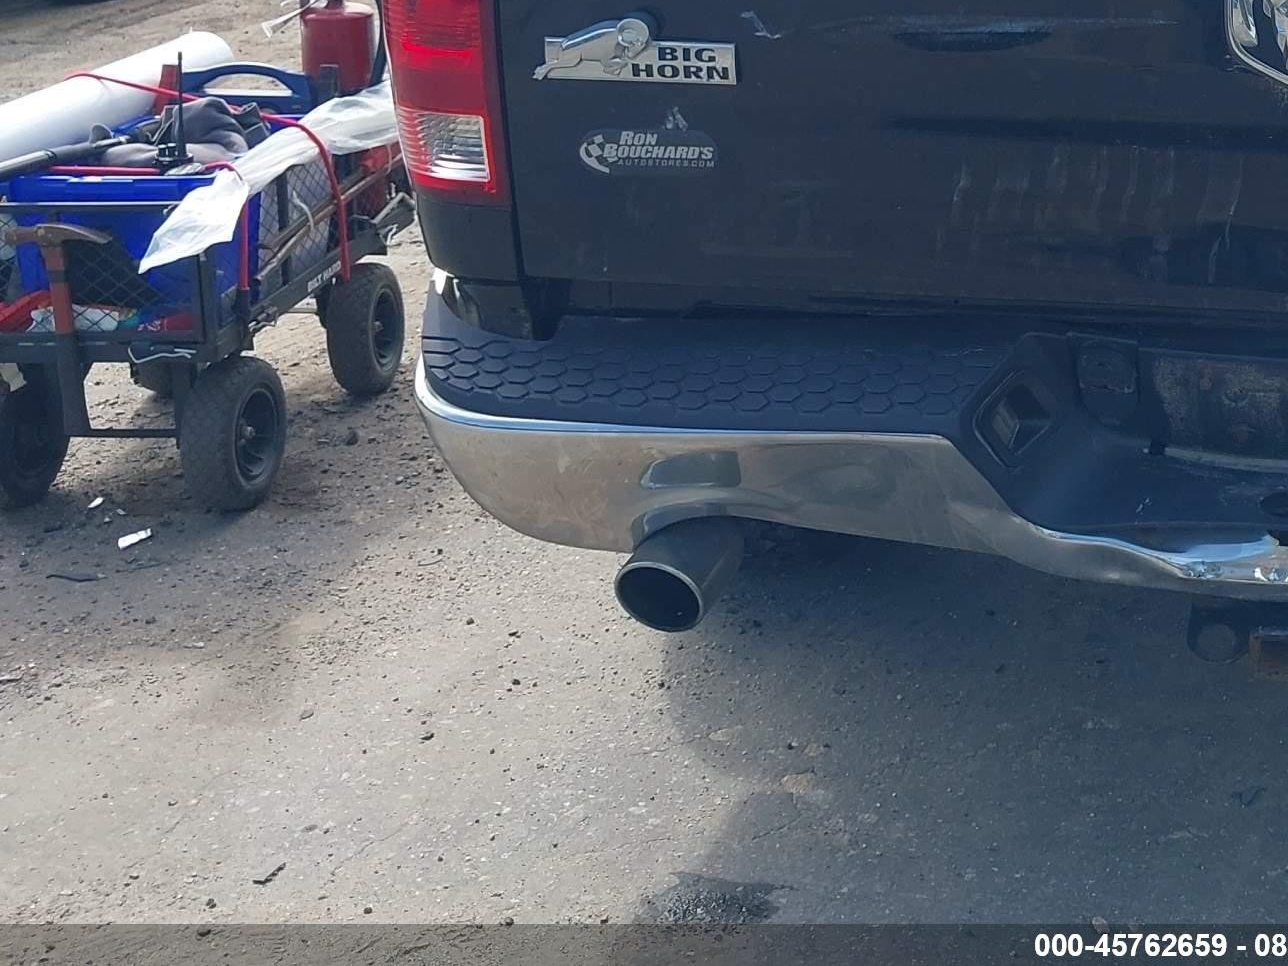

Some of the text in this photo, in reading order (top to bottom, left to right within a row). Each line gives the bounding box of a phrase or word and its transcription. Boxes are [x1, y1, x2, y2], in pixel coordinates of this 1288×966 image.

[658, 46, 716, 63] BIG
[631, 63, 730, 81] HORN
[620, 130, 658, 146] RON
[603, 143, 714, 159] BOUCHARD'S
